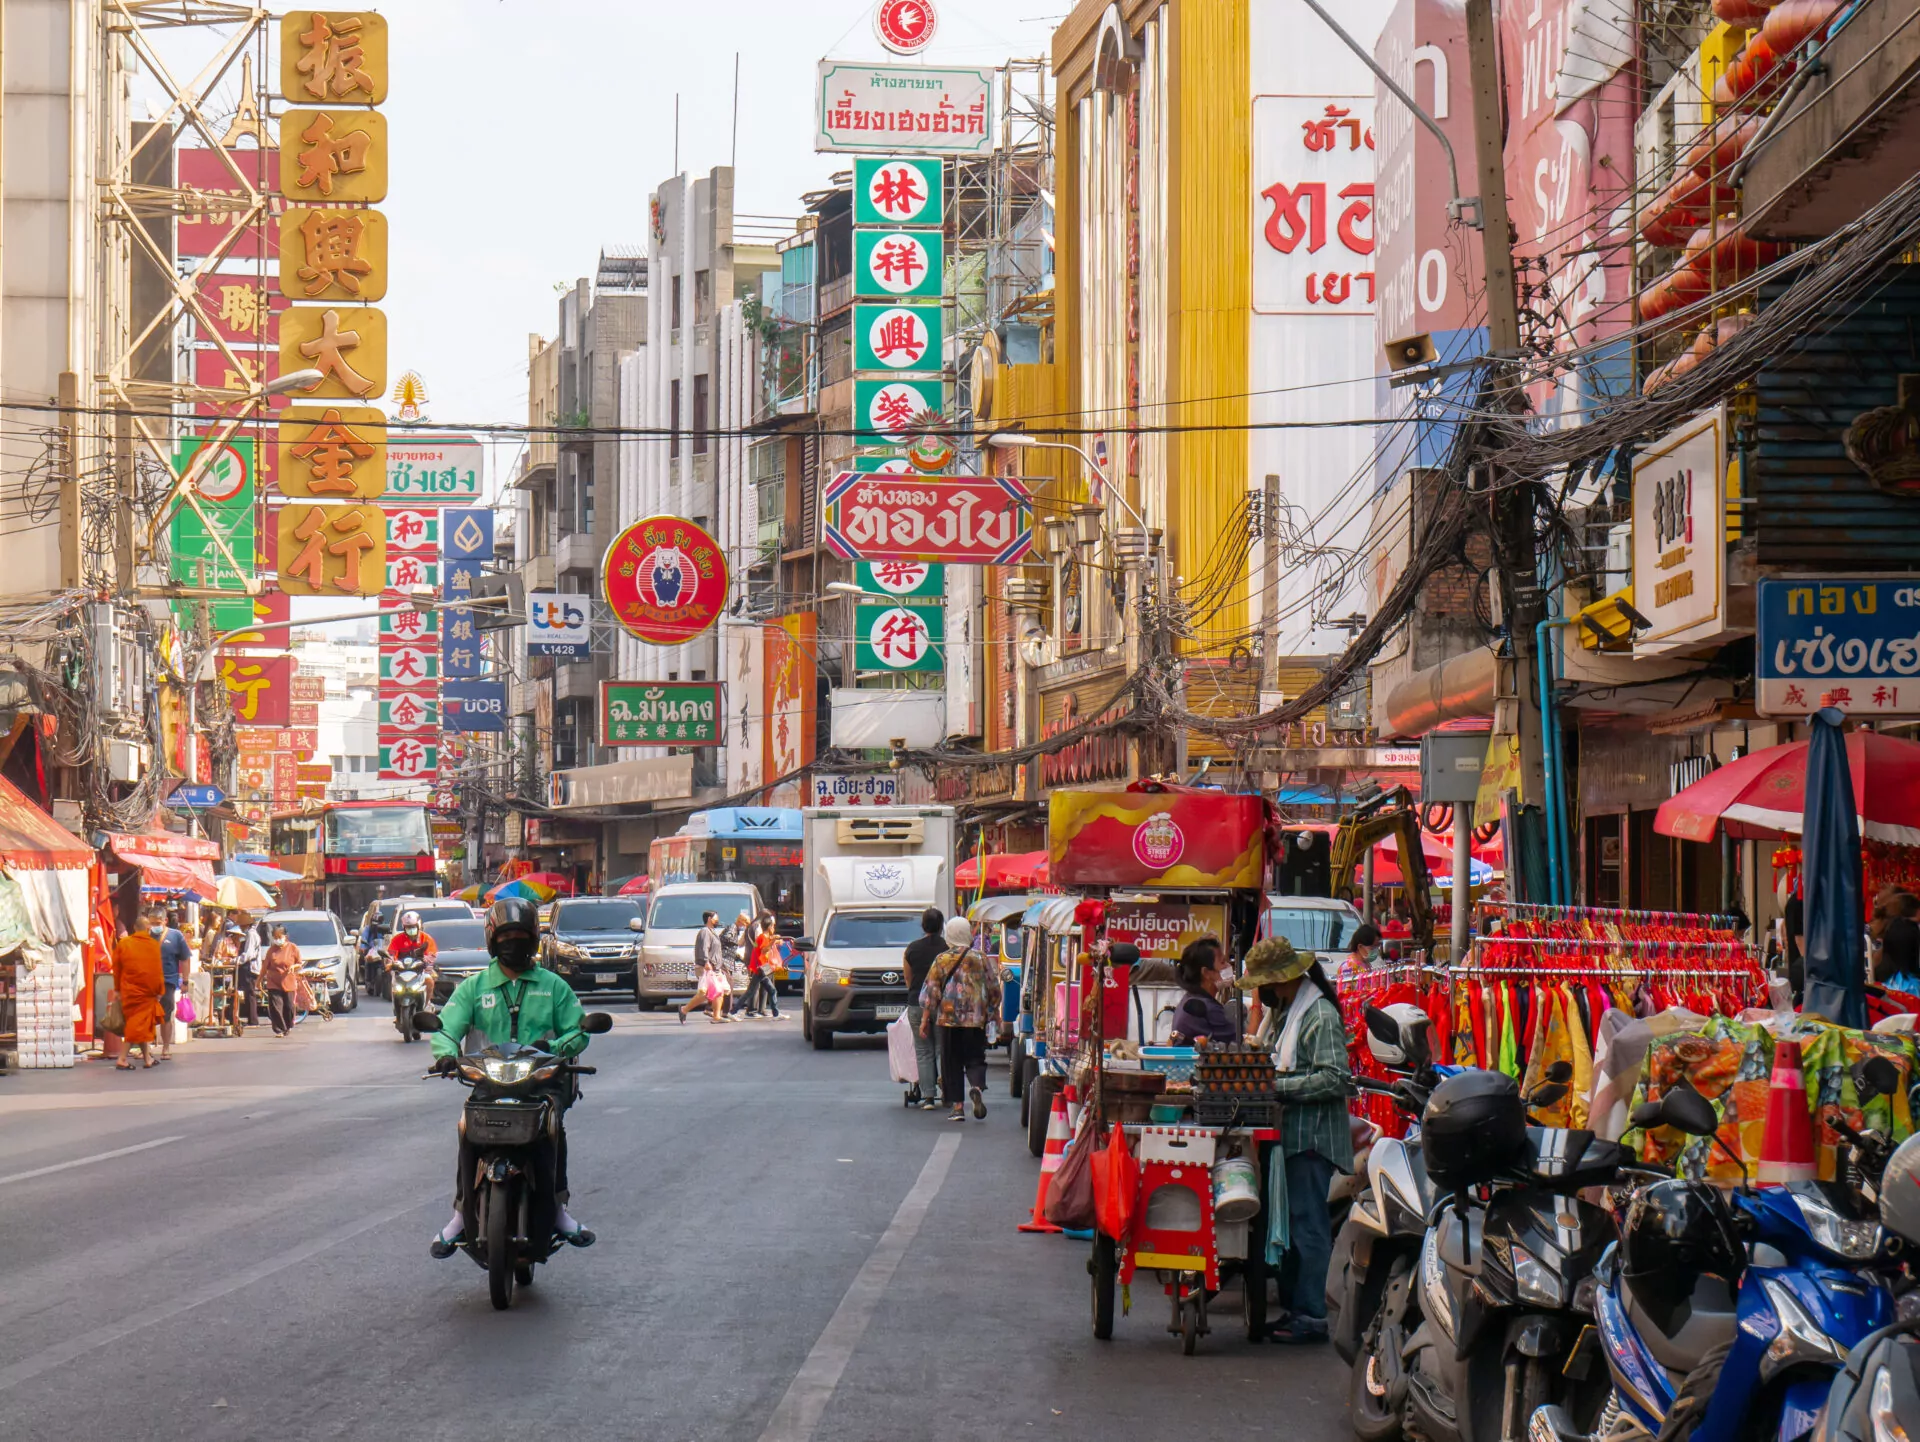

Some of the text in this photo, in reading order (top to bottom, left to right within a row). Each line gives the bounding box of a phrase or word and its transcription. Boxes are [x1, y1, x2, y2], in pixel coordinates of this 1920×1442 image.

[287, 12, 376, 592] 振和興大金行
[856, 482, 937, 506] ห้างทอง
[846, 489, 1012, 549] ทองใบ
[1787, 584, 1878, 616] ทอง
[532, 601, 585, 630] ttb
[550, 645, 575, 655] 1428
[463, 697, 502, 713] UOB
[610, 686, 714, 722] ฉ.มั่นคง
[206, 789, 215, 802] 6
[1106, 909, 1210, 933] ะหมี่เย็นตาโฟ
[1134, 933, 1179, 952] ต้มยำ
